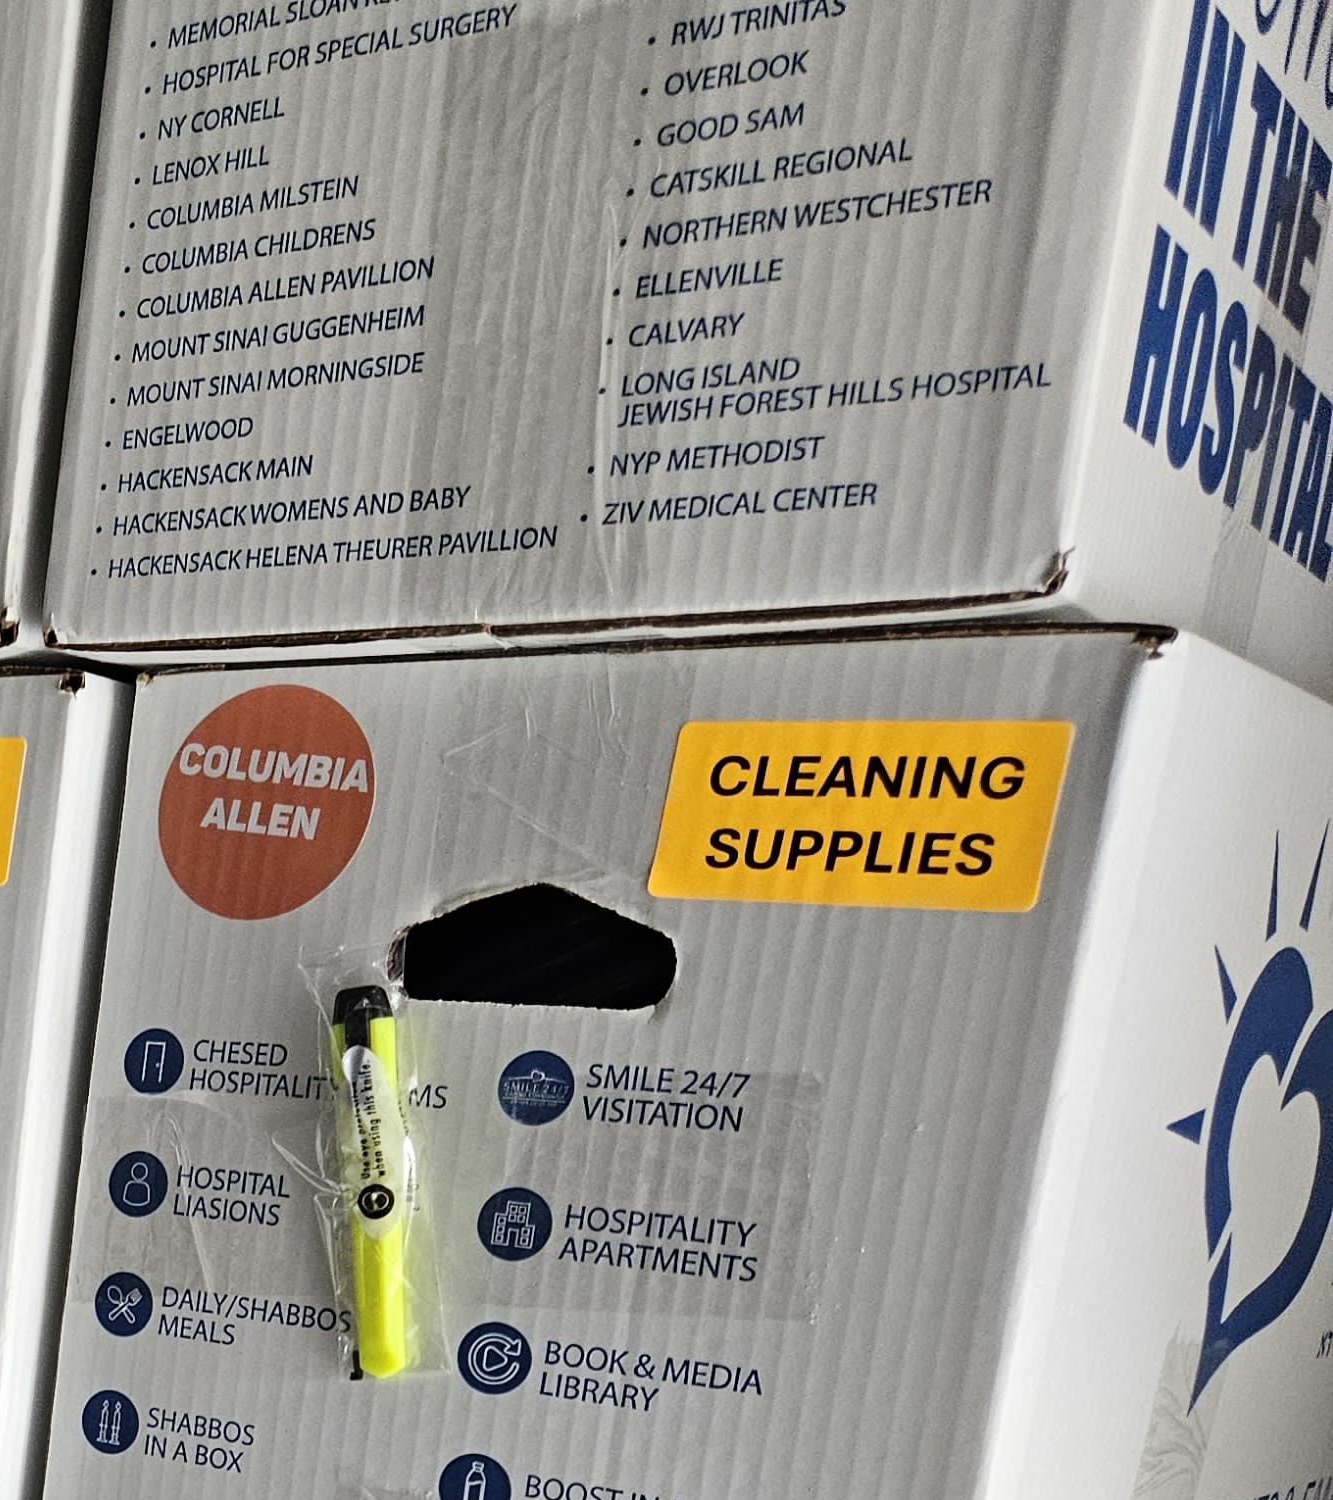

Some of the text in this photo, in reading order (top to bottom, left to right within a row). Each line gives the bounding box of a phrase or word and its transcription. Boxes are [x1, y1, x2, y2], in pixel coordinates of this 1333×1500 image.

[163, 56, 261, 94] HOSPITAL
[315, 29, 403, 64] SPECIAL
[409, 7, 515, 45] SURGERY
[665, 51, 808, 95] OVERLOOK
[658, 105, 804, 146] GOOD SAM
[1164, 0, 1332, 336] IN THE
[643, 180, 992, 248] NORTHERN WESTCHESTER
[137, 257, 434, 318] COLUMBIA ALLEN PAVILLION
[636, 260, 782, 298] ELLENVILLE
[618, 367, 1050, 427] JEWISH FOREST HILLS HOSPITAL
[1123, 223, 1333, 583] HOSPITAL
[603, 483, 877, 524] ZIV MEDICAL CENTER
[109, 526, 557, 578] HACKENSACK HELENA THEURER PAVILLION
[175, 740, 367, 792] COLUMBIA
[711, 756, 1024, 799] CLEANING
[200, 798, 320, 840] ALLEN
[706, 829, 994, 875] SUPPLIES
[194, 1040, 287, 1066] CHESED
[587, 1064, 750, 1098] SMILE 24/7
[365, 1095, 375, 1117] this
[583, 1096, 743, 1131] VISITATION
[371, 1118, 381, 1149] using
[177, 1166, 290, 1198] HOSPITAL
[174, 1194, 280, 1226] LIASIONS
[565, 1206, 757, 1246] HOSPITALITY
[559, 1237, 757, 1281] APARTMENTS
[158, 1315, 235, 1345] MEALS
[162, 1287, 351, 1333] DAILY/SHABBOS
[545, 1342, 761, 1395] BOOK & MEDIA
[540, 1372, 659, 1411] LIBRARY
[147, 1408, 254, 1445] SHABBOS
[145, 1435, 243, 1473] IN A BOX
